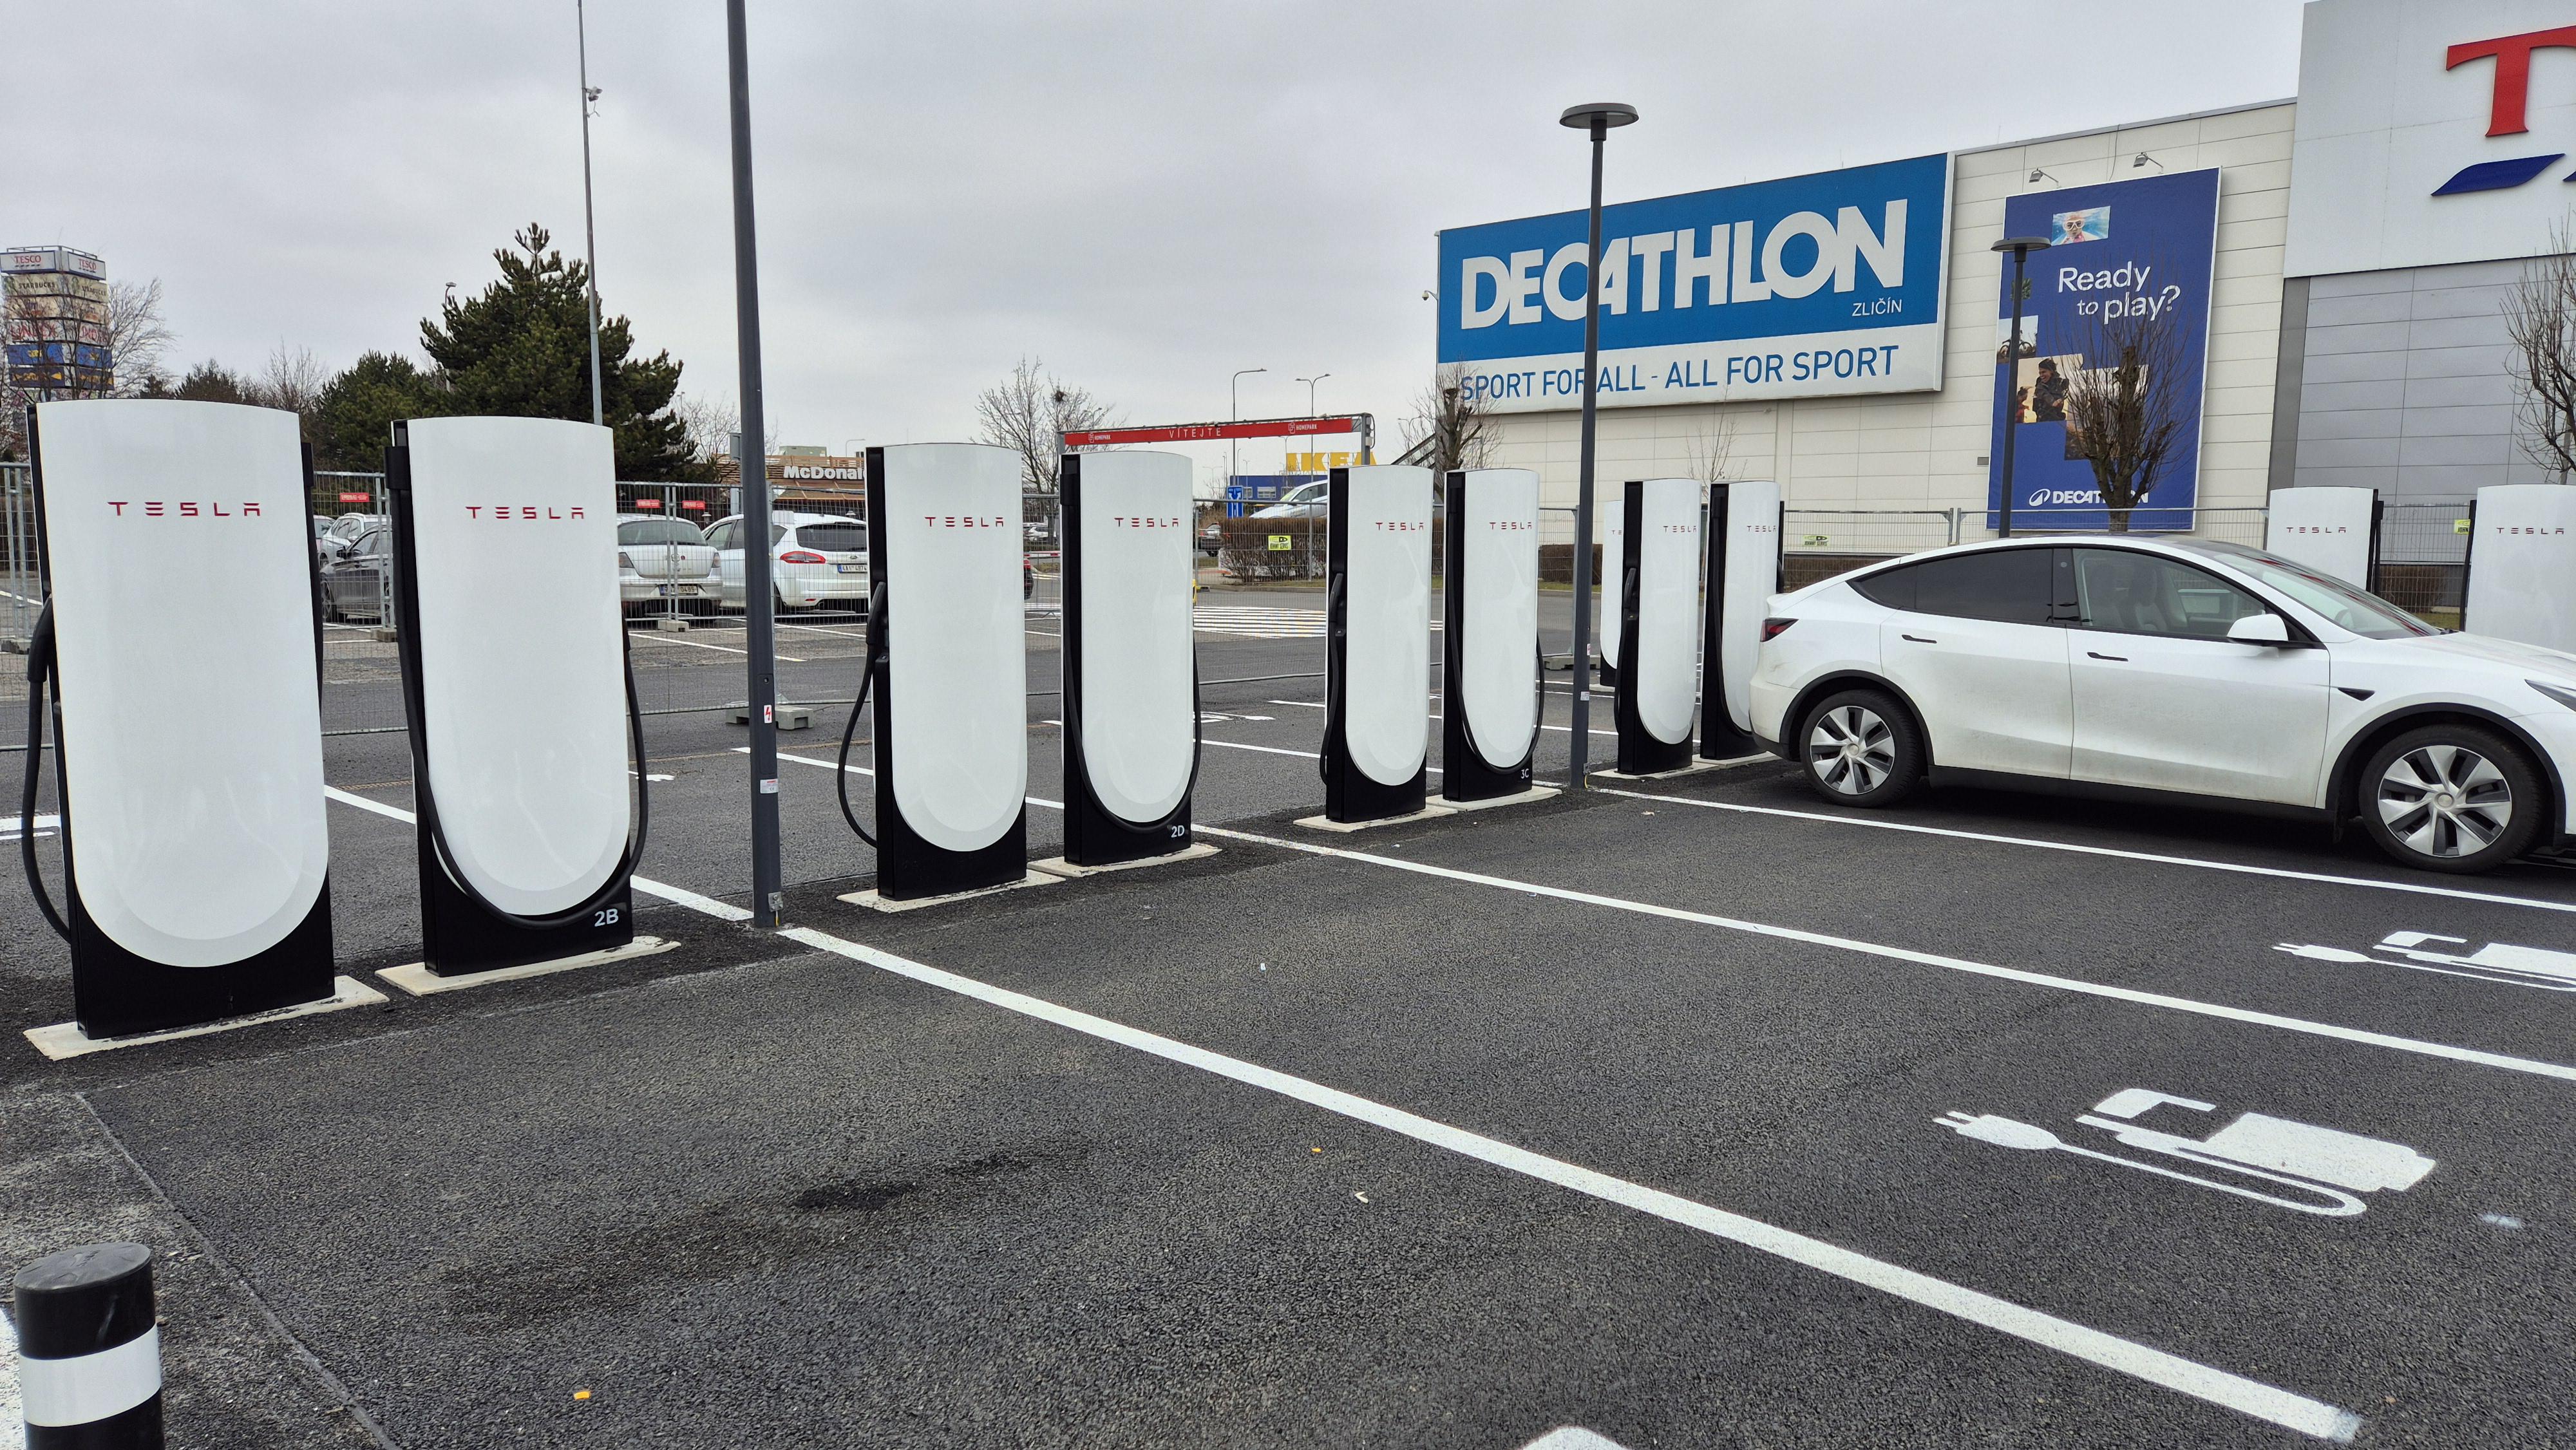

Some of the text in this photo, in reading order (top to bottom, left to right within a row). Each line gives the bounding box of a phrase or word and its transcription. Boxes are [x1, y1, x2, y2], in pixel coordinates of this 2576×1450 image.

[14, 255, 41, 264] TESCO
[78, 258, 97, 270] TESCO
[1461, 198, 1909, 330] DECATHLON
[2058, 261, 2151, 293] Ready
[1852, 296, 1902, 317] ZLIČÍN
[2076, 285, 2181, 325] to play?
[1461, 372, 1536, 400] SPORT
[1596, 364, 1646, 393] ALL
[1665, 359, 1718, 389] ALL
[1727, 353, 1783, 385] FOR
[1792, 344, 1899, 381] SPORT
[1169, 427, 1222, 438] VÍTEJTE
[1286, 451, 1377, 471] IKEA
[783, 466, 866, 480] McDonal
[107, 502, 261, 516] TESLA
[465, 506, 584, 519] TESLA
[925, 516, 1004, 527] TESLA
[1114, 517, 1179, 527] TESLA
[1375, 522, 1424, 531] TESLA
[1489, 522, 1532, 530] TESLA
[1520, 768, 1530, 779] 3C
[1171, 825, 1185, 838] 2D
[594, 908, 619, 927] 2B
